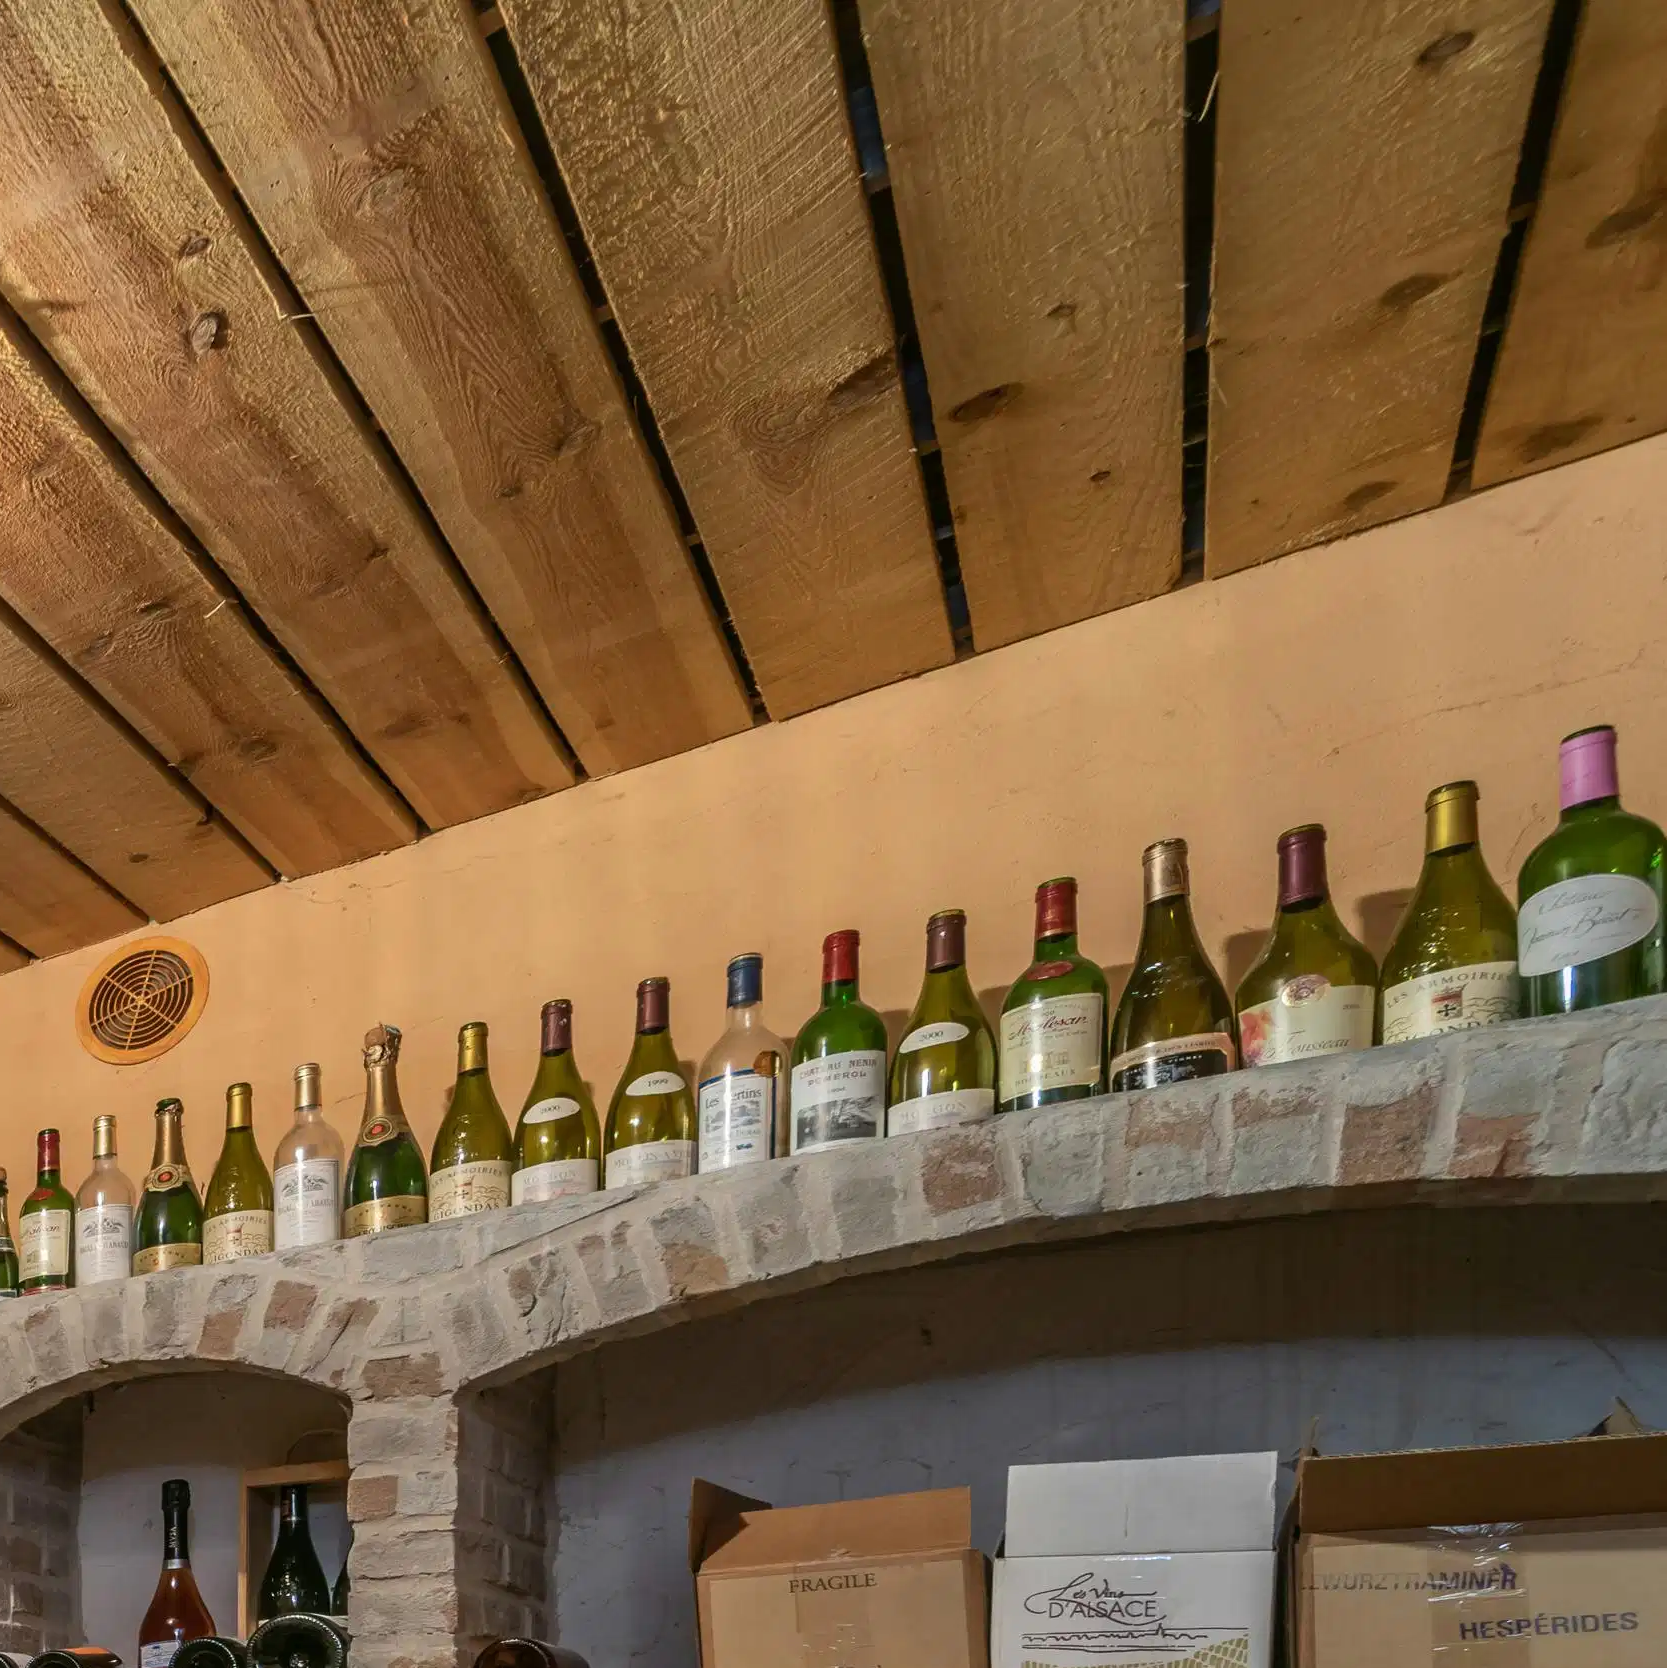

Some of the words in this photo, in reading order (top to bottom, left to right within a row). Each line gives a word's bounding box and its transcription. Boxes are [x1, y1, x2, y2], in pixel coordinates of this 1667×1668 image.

[788, 1572, 877, 1594] FRAGILE
[1048, 1599, 1158, 1618] D'ALSACE
[1459, 1612, 1640, 1641] HESPÉRIDES
